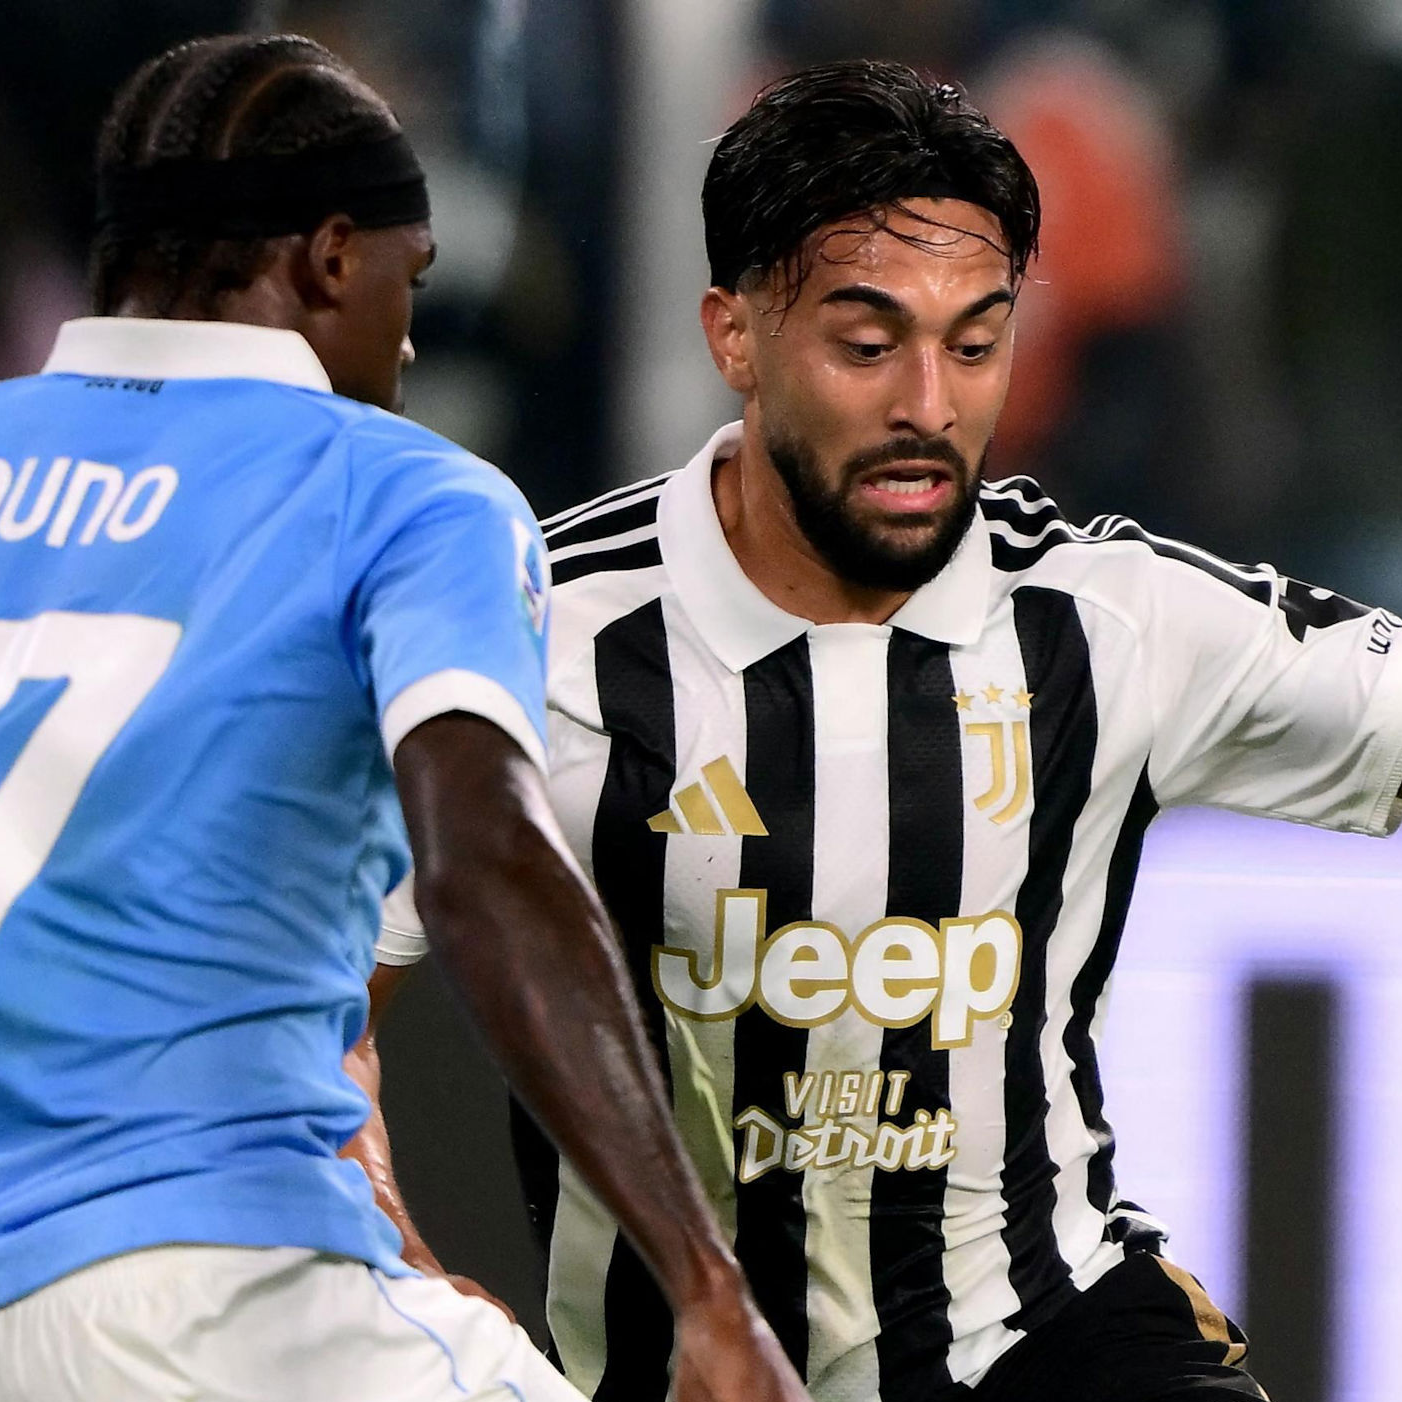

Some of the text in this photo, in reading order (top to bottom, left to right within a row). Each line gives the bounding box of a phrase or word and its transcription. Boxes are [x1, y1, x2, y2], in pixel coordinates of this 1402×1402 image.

[651, 888, 1024, 1050] Jeep
[783, 1069, 912, 1118] VISIT
[732, 1103, 958, 1184] Detroit
